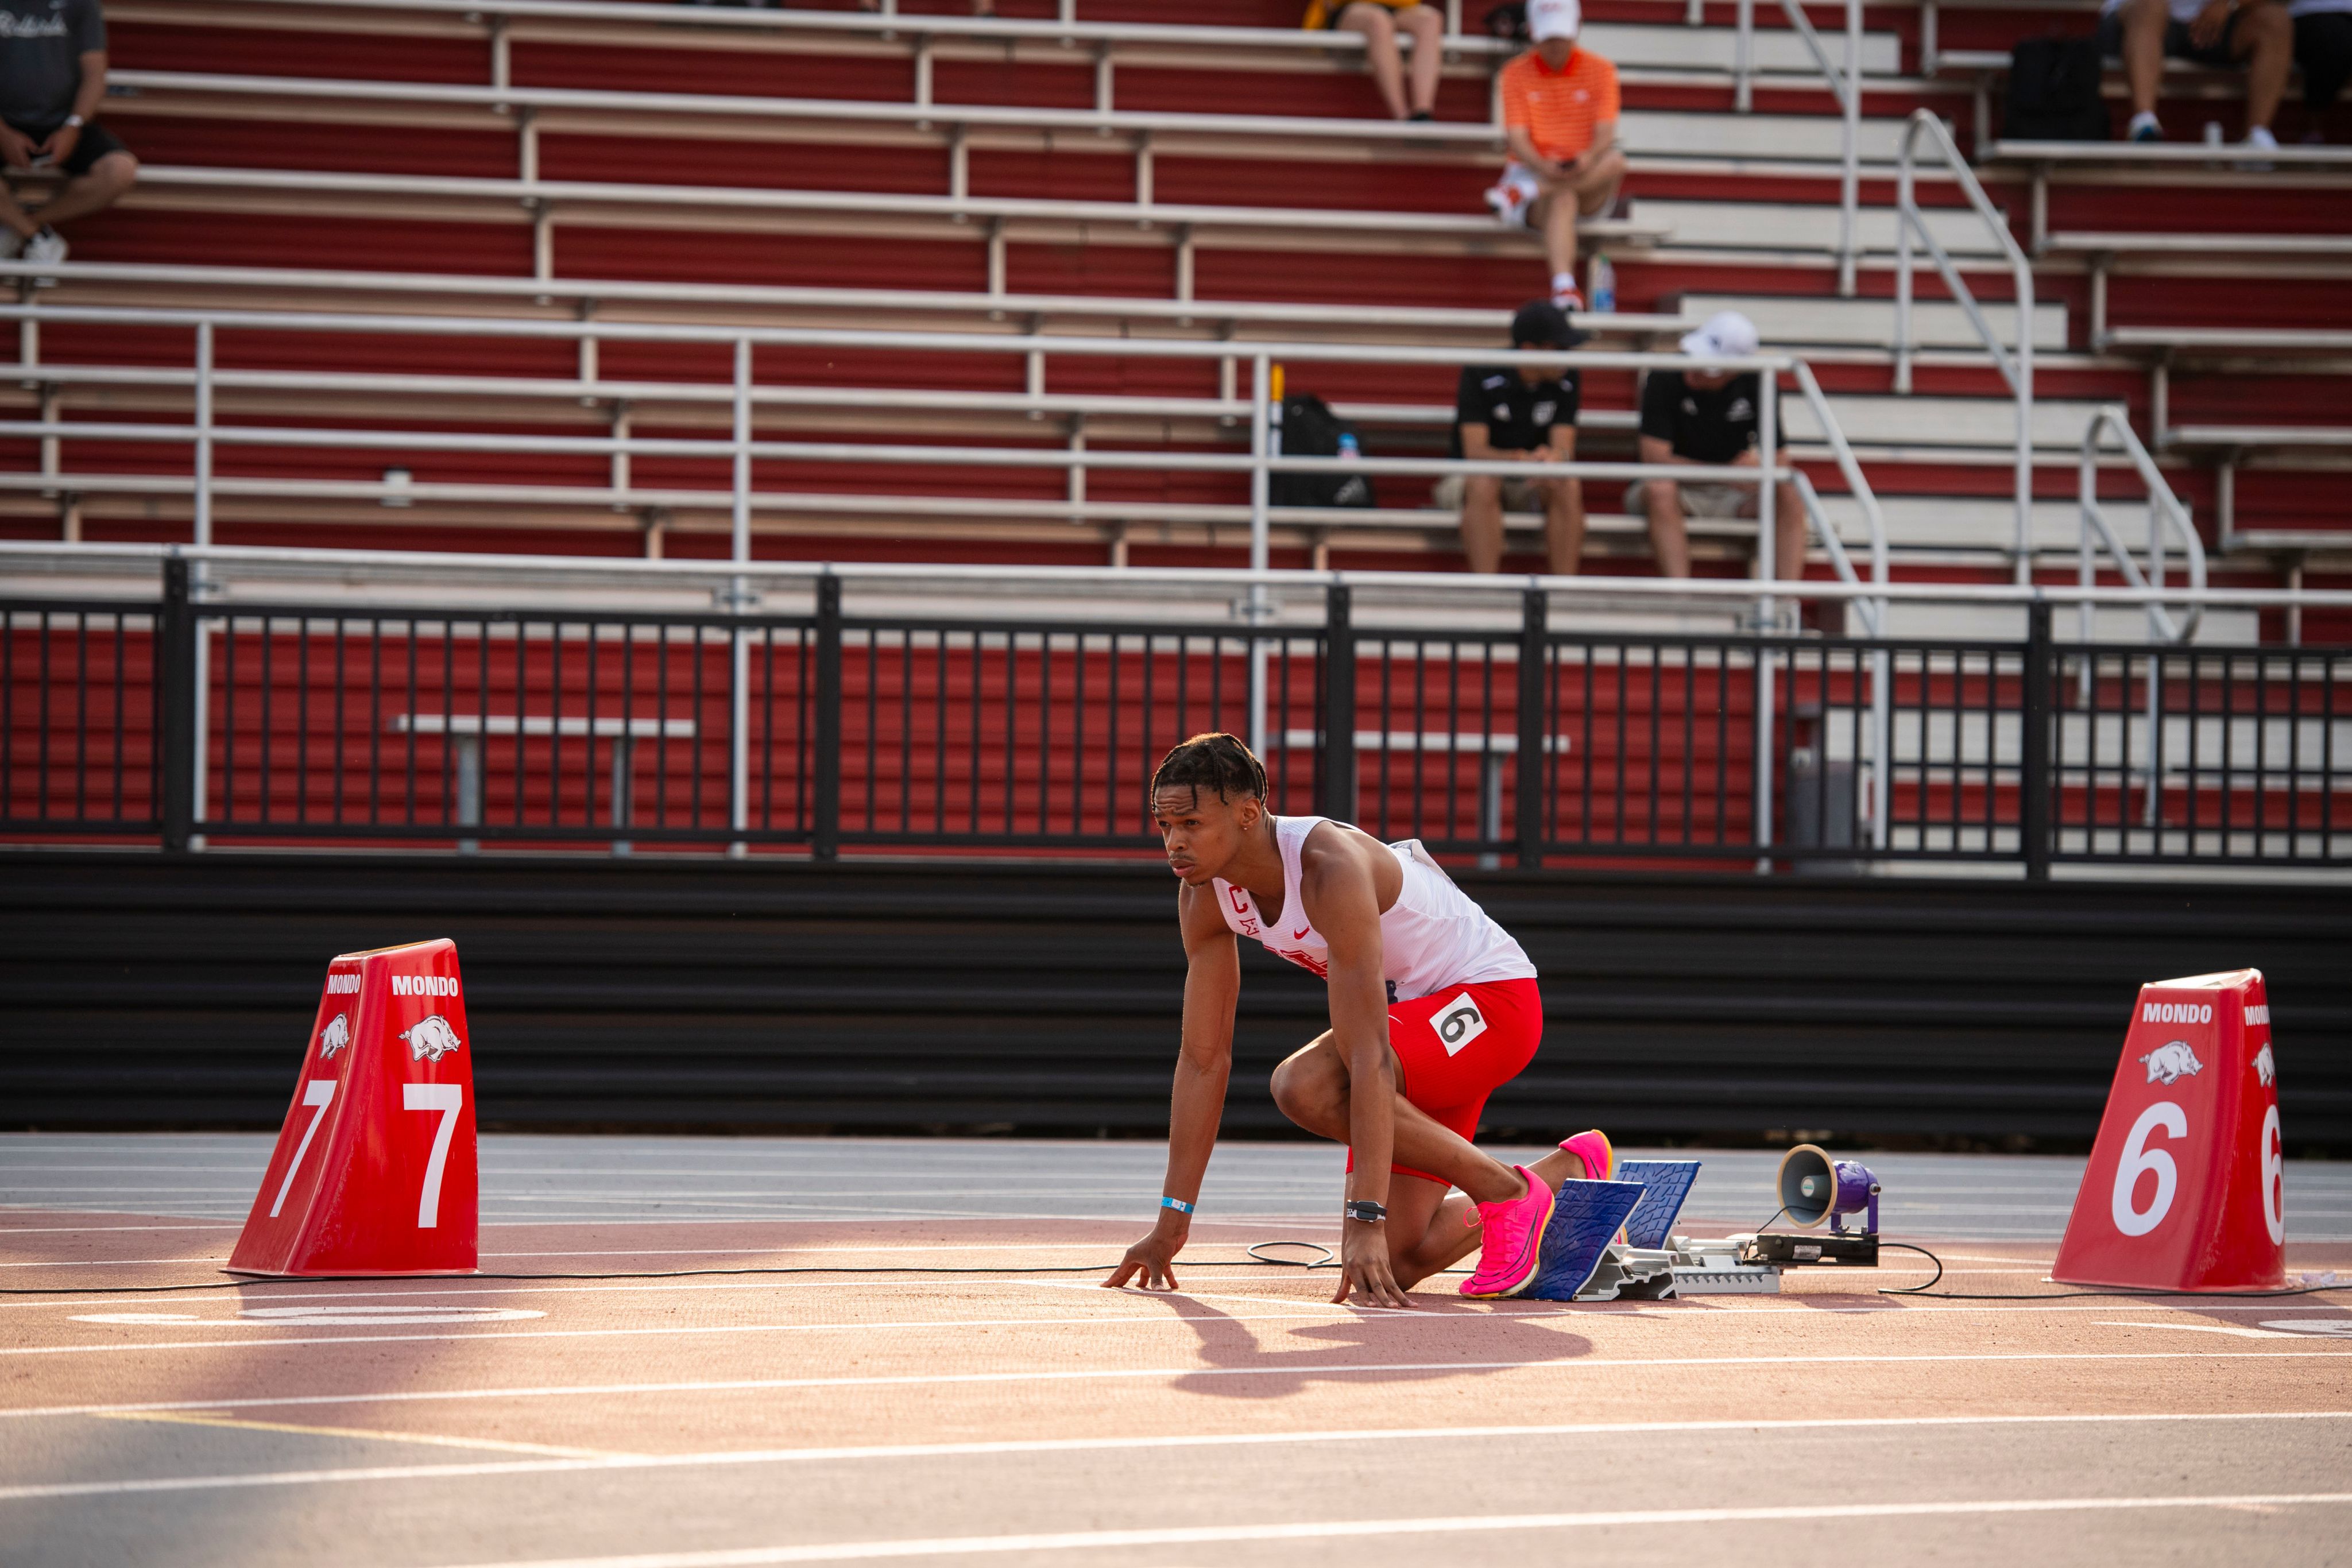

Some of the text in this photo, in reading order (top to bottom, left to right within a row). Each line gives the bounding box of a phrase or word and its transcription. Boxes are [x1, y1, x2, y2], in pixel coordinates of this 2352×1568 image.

[327, 974, 361, 994] MONDO
[392, 975, 458, 997] MONDO
[1440, 1007, 1480, 1043] 6
[2143, 1003, 2212, 1024] MONDO
[269, 1080, 338, 1218] 7
[403, 1083, 462, 1228] 7
[2112, 1101, 2188, 1237] 6
[2262, 1105, 2285, 1246] 6
